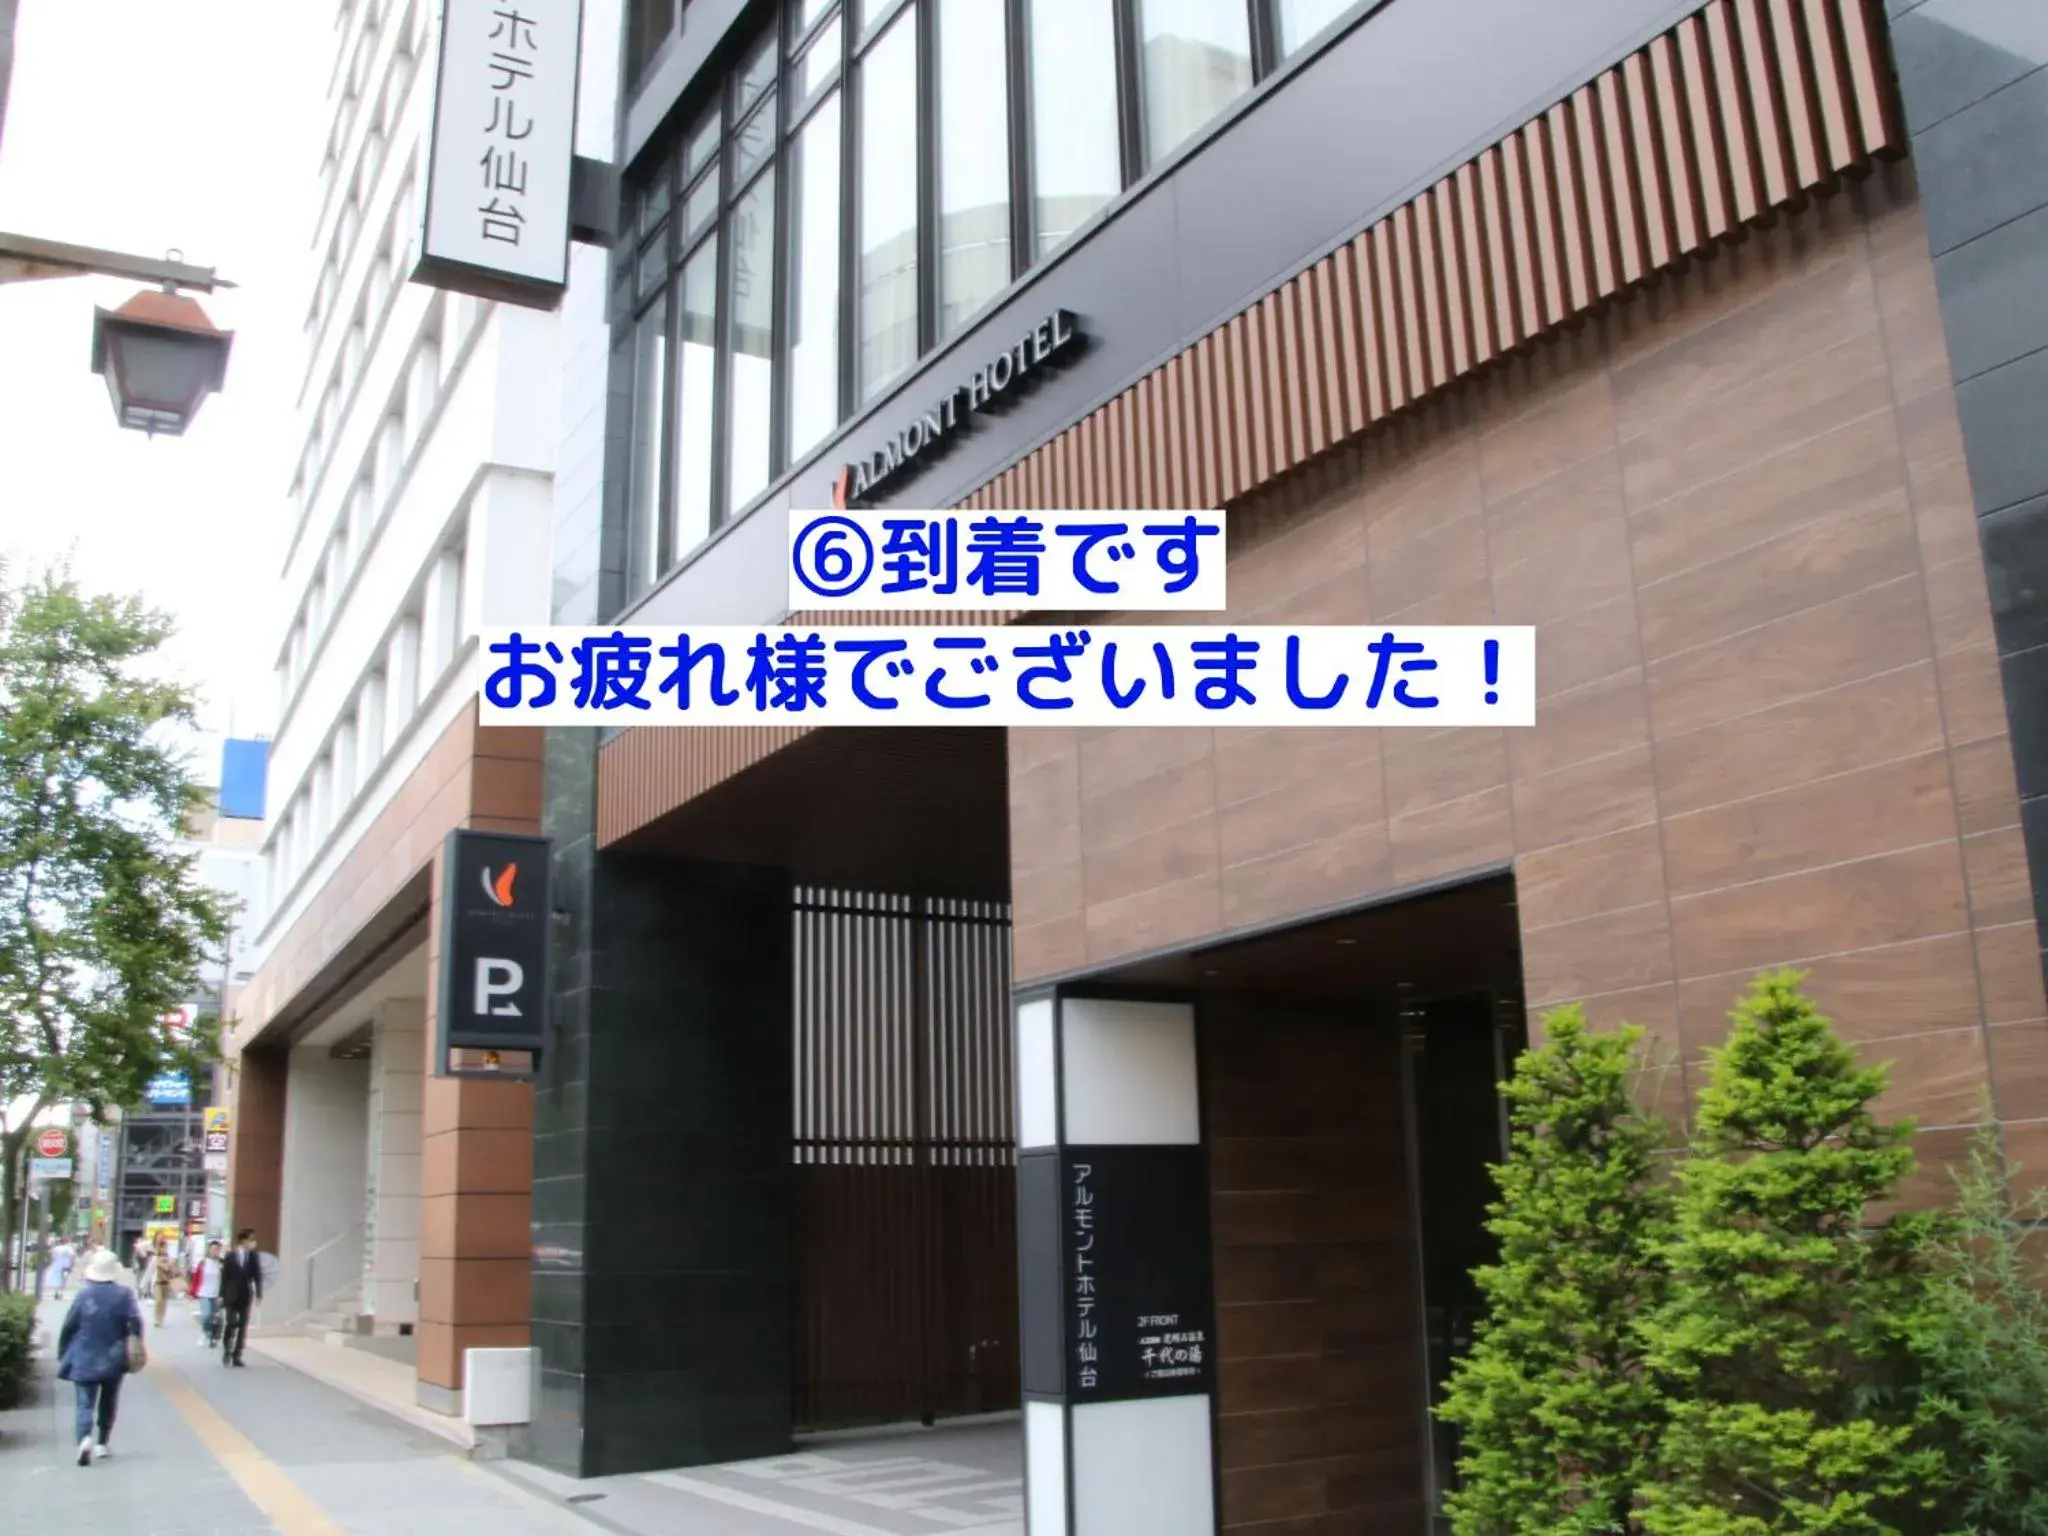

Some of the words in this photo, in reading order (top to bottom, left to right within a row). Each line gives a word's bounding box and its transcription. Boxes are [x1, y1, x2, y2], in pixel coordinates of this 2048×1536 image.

[478, 9, 538, 247] ホテル仙台
[850, 392, 961, 499] ALMONT
[968, 308, 1073, 411] HOTEL
[473, 956, 524, 1016] P
[1073, 1164, 1098, 1388] アルモントホテル仙台
[1150, 1314, 1179, 1326] FRONT
